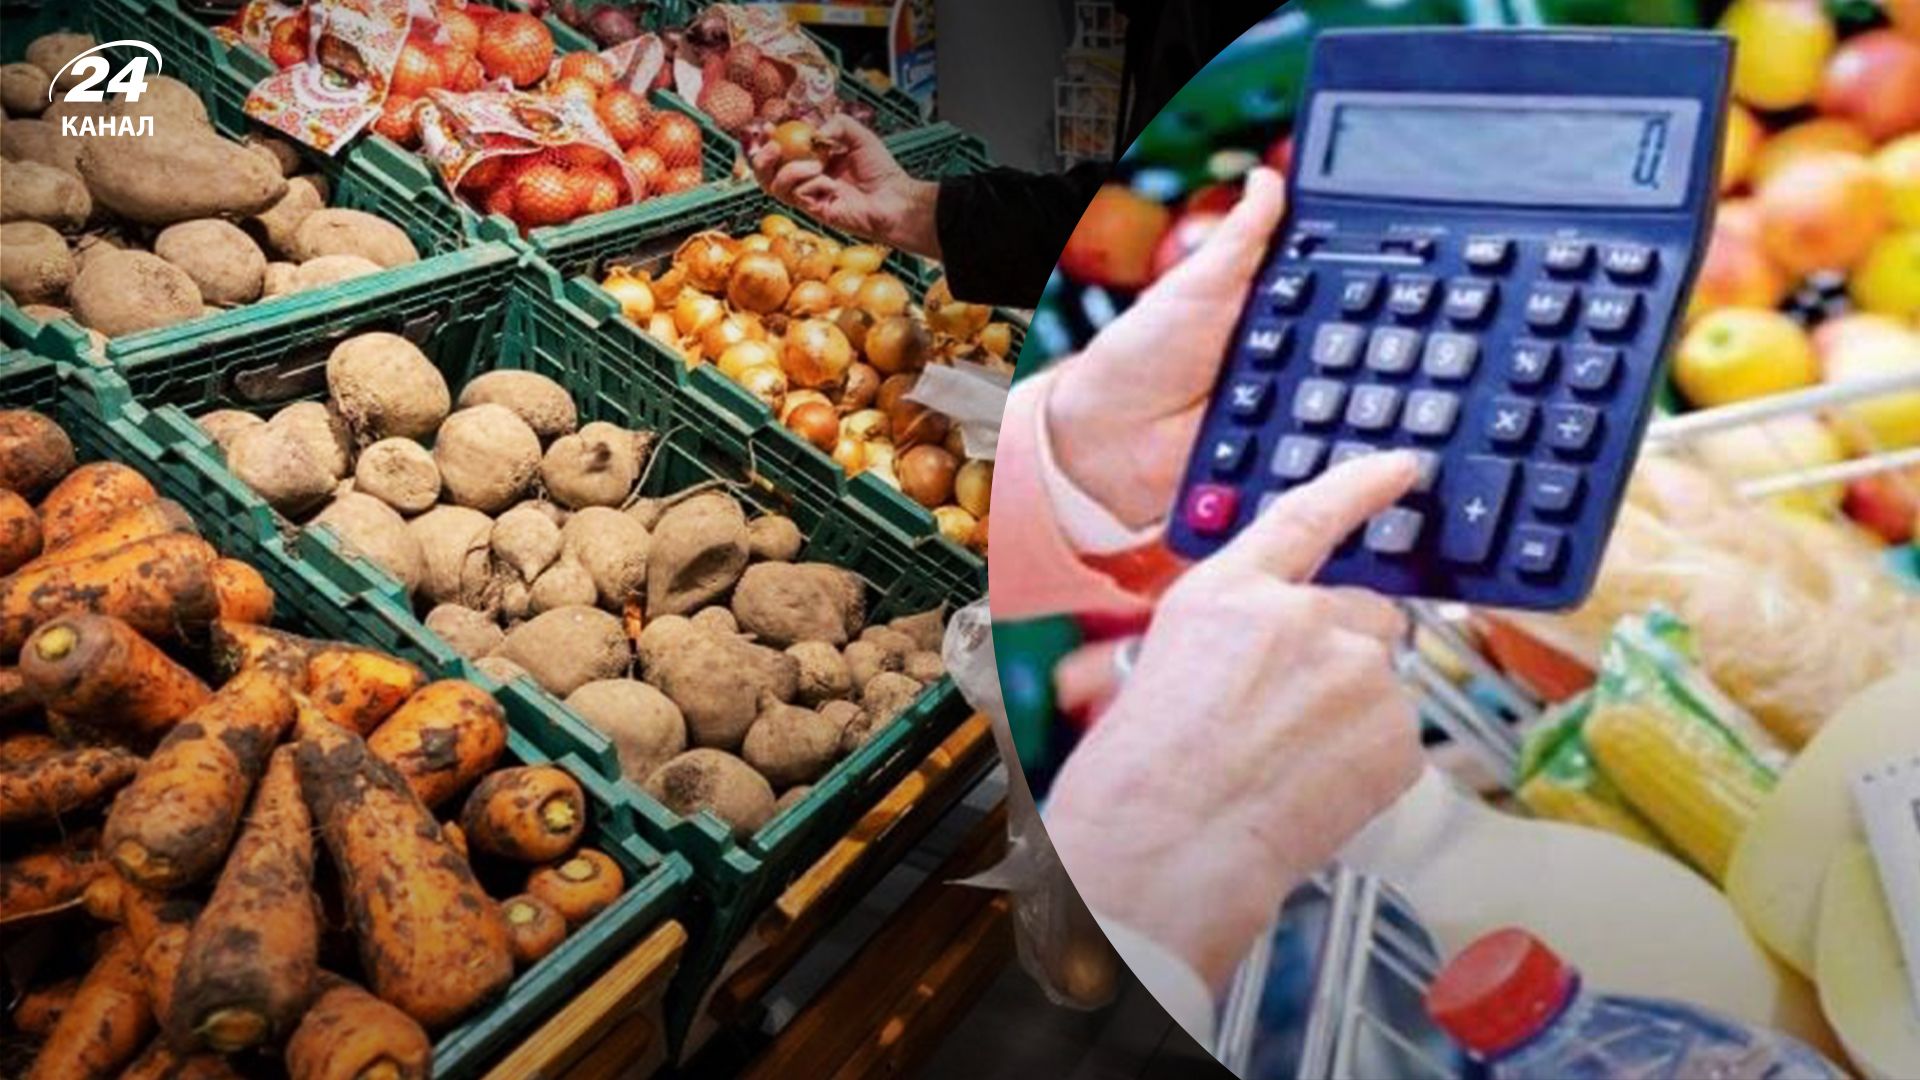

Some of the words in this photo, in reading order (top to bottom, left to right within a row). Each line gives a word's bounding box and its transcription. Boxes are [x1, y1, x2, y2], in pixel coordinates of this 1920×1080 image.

[1380, 337, 1398, 360] 8
[1438, 344, 1456, 366] 9
[1197, 493, 1219, 519] C
